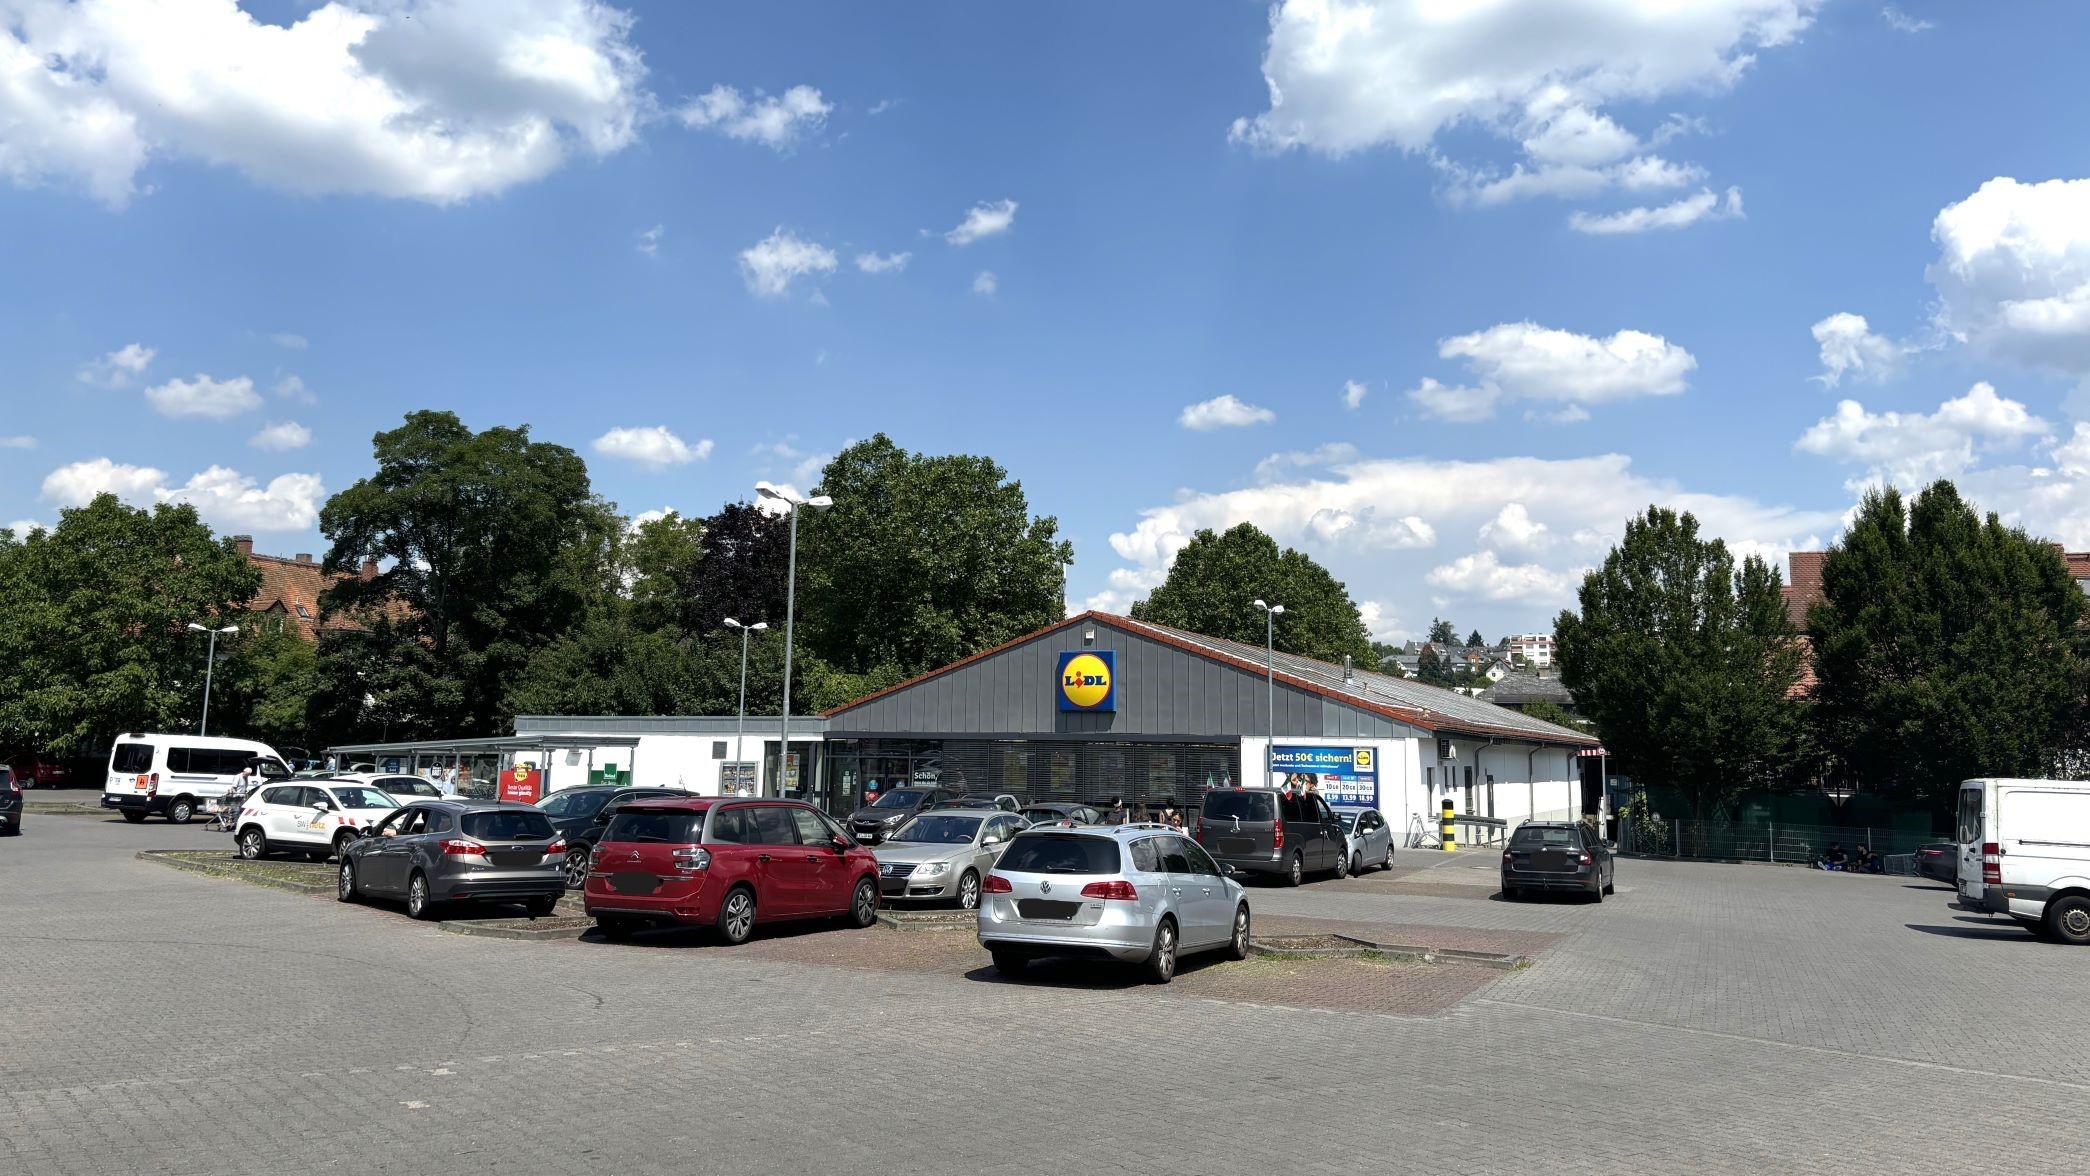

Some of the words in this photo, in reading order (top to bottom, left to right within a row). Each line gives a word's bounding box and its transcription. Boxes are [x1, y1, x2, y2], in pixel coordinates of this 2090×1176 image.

[1272, 753, 1294, 761] Jetzt
[1295, 753, 1313, 762] 50€
[1315, 753, 1352, 763] sichern!
